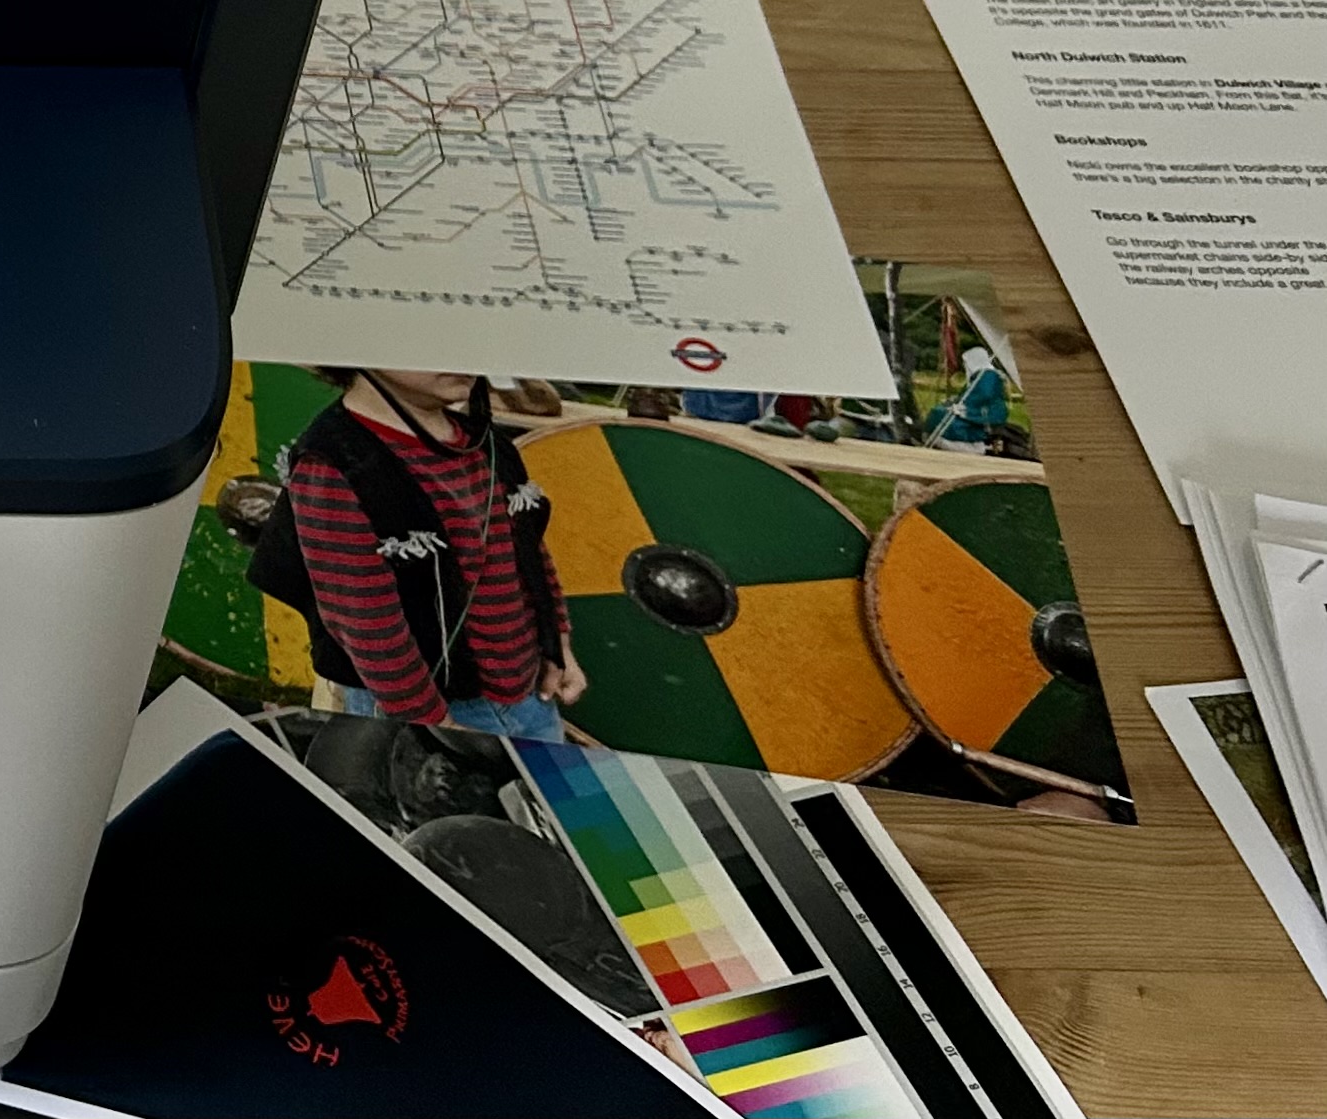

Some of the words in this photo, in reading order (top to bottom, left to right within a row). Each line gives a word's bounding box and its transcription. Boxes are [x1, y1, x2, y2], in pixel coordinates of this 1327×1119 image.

[1011, 51, 1057, 61] North
[1061, 52, 1126, 63] Dulwich
[1128, 53, 1187, 63] Station
[1214, 79, 1272, 88] Dulwich
[1054, 133, 1148, 148] Bookshops
[1090, 209, 1142, 221] Tesco
[1147, 212, 1159, 222] &
[1162, 212, 1256, 225] Sainsburys
[1129, 238, 1184, 249] through
[1187, 239, 1210, 248] the
[1213, 240, 1257, 248] tunnel
[1260, 240, 1300, 249] under
[1113, 251, 1200, 262] supermarket
[1203, 253, 1250, 262] chains
[1118, 263, 1142, 272] the
[1187, 278, 1218, 290] they
[1222, 279, 1274, 288] include
[267, 991, 340, 1067] HEVE
